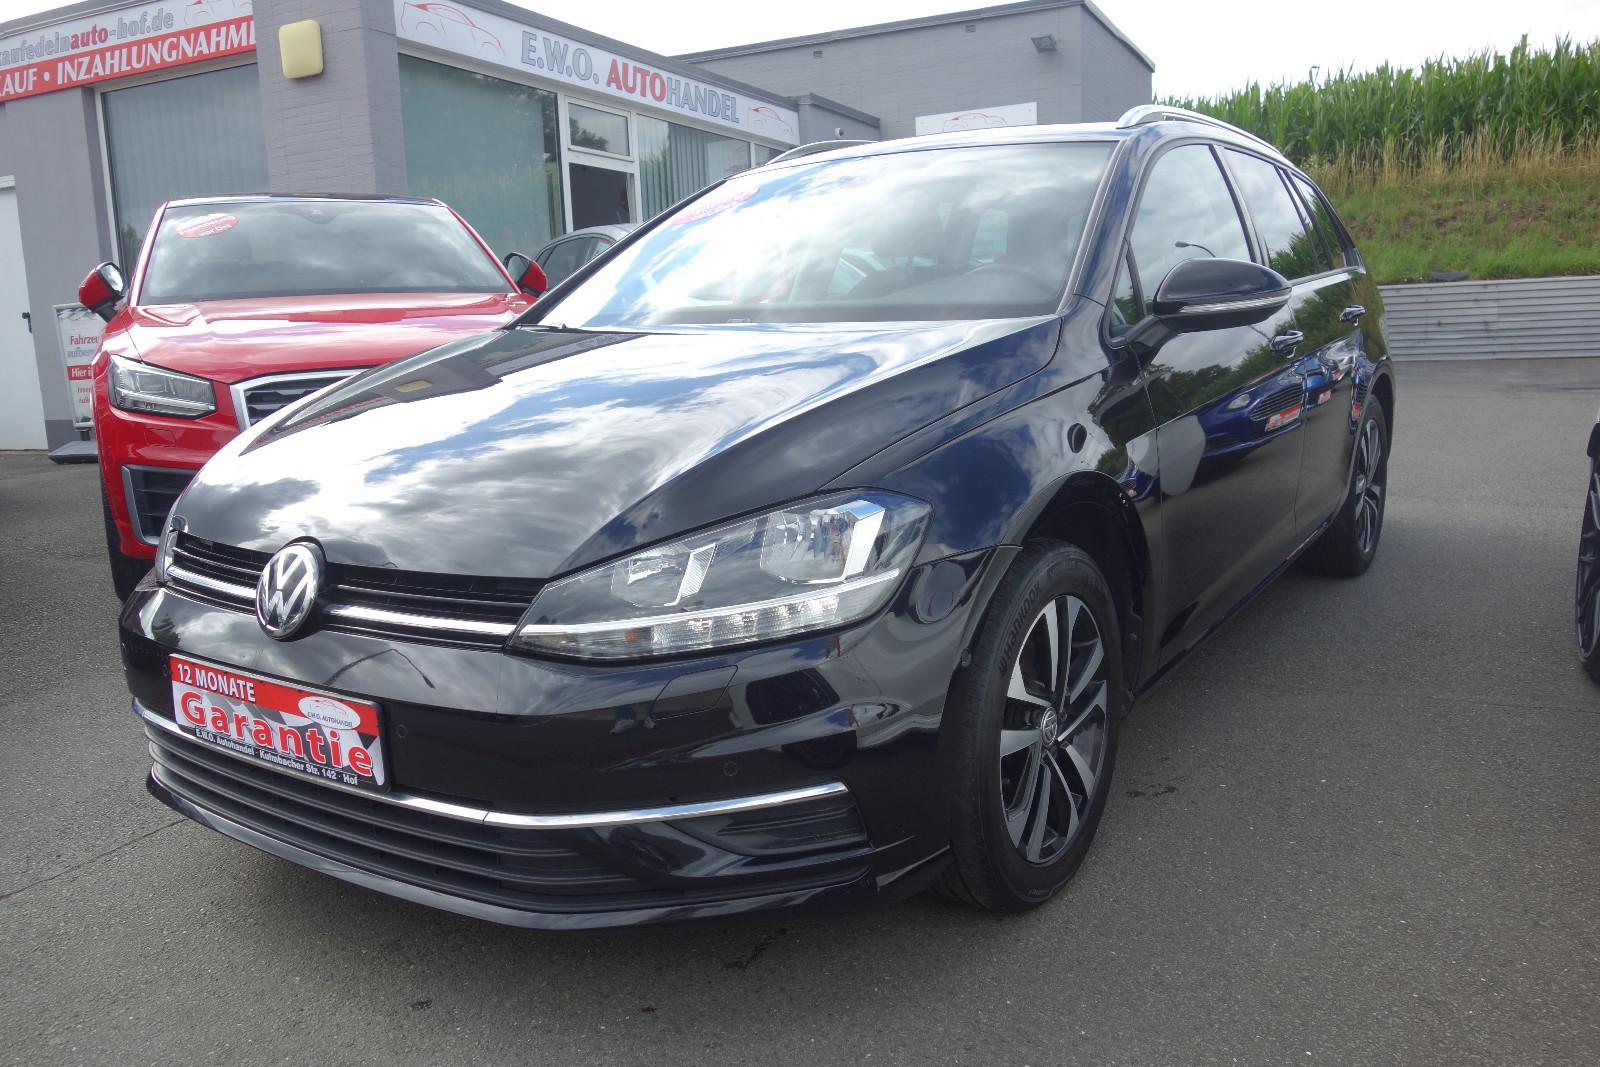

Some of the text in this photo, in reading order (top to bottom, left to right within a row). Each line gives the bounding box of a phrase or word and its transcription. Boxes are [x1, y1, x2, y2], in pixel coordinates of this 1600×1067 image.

[0, 8, 174, 67] aufedeinauto-hof.de
[0, 67, 38, 97] AUF
[521, 30, 740, 124] E.W.O. AUTOHANDEL
[71, 367, 86, 378] Hier
[177, 664, 256, 703] 12 MONATE
[180, 690, 374, 777] Garantie
[217, 735, 255, 756] Autohandel
[259, 749, 304, 771] Kulmbacher
[306, 763, 320, 776] Str.
[321, 768, 337, 780] 142
[342, 773, 359, 786] Hof
